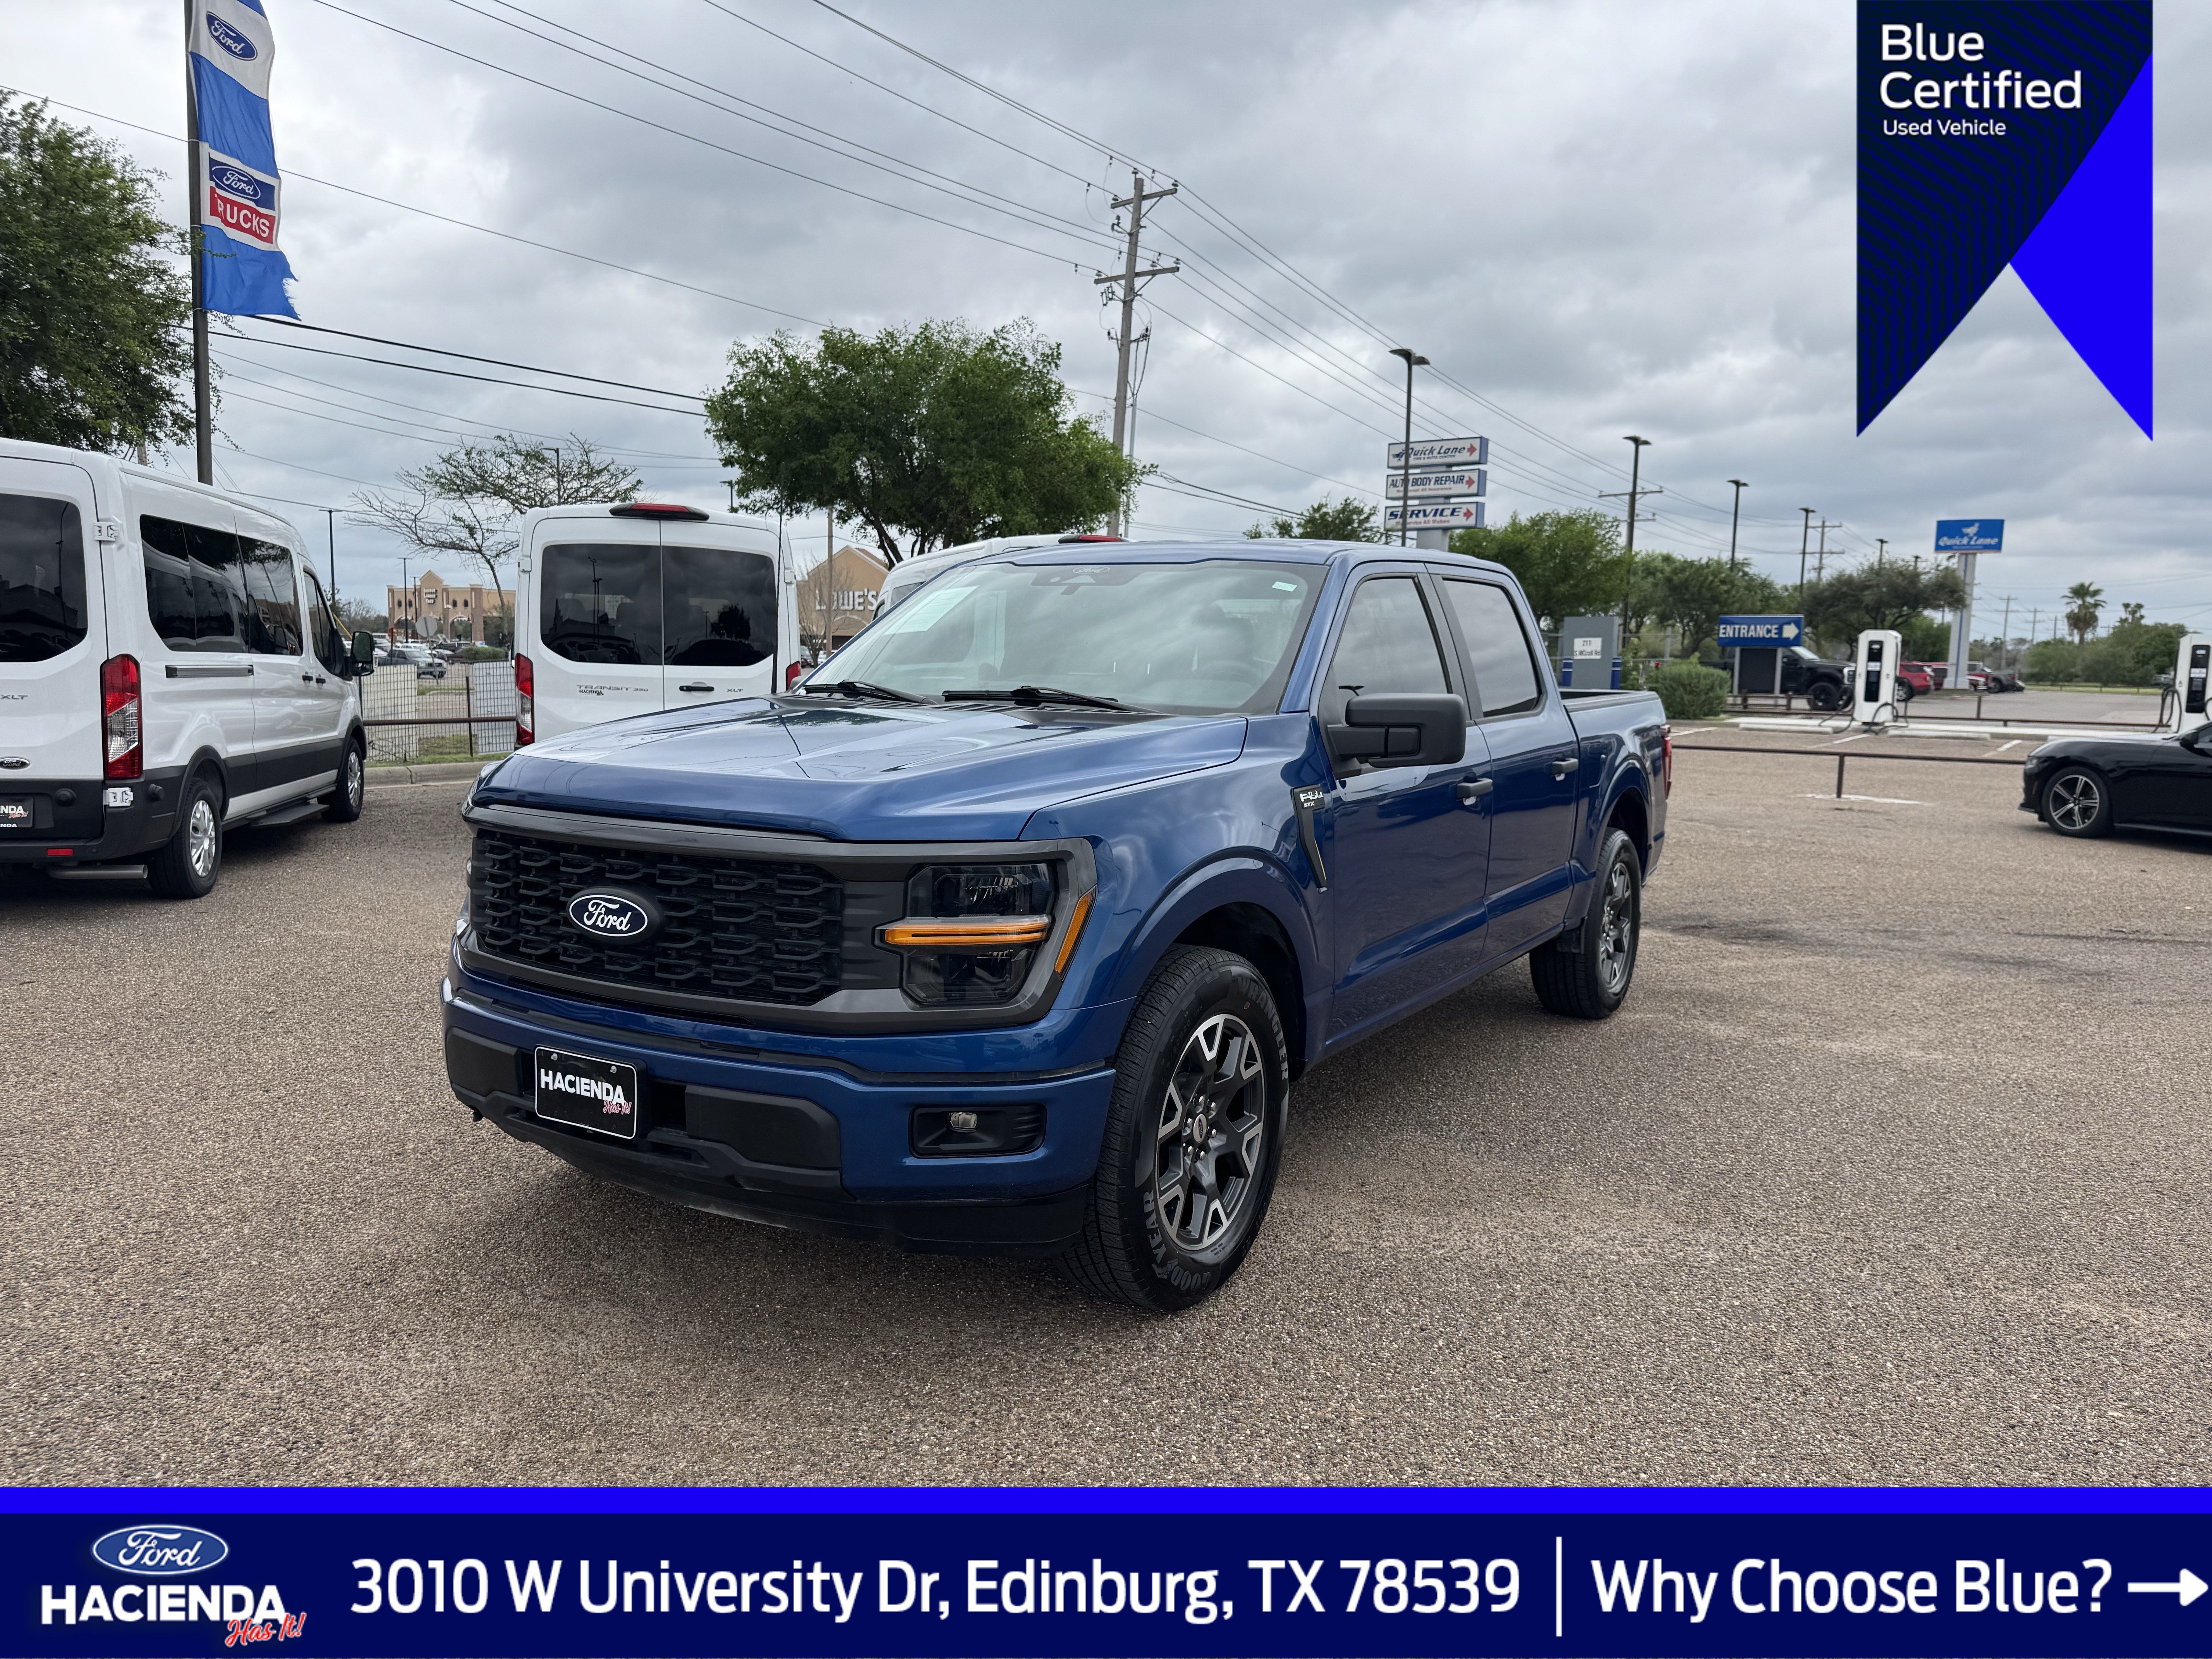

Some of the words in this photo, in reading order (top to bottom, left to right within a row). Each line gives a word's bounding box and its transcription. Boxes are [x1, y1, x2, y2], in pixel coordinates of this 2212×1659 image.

[211, 21, 246, 54] Ford
[223, 171, 254, 194] Ford
[215, 194, 270, 237] RUCKS
[1437, 445, 1466, 455] Lane
[1389, 478, 1408, 488] AUT
[1411, 476, 1433, 487] BODY
[1434, 475, 1465, 486] REPAIR
[1719, 624, 1779, 638] ENTRANCE
[584, 900, 632, 931] Ford
[541, 1068, 625, 1106] HACIENDA
[603, 1100, 621, 1114] Has
